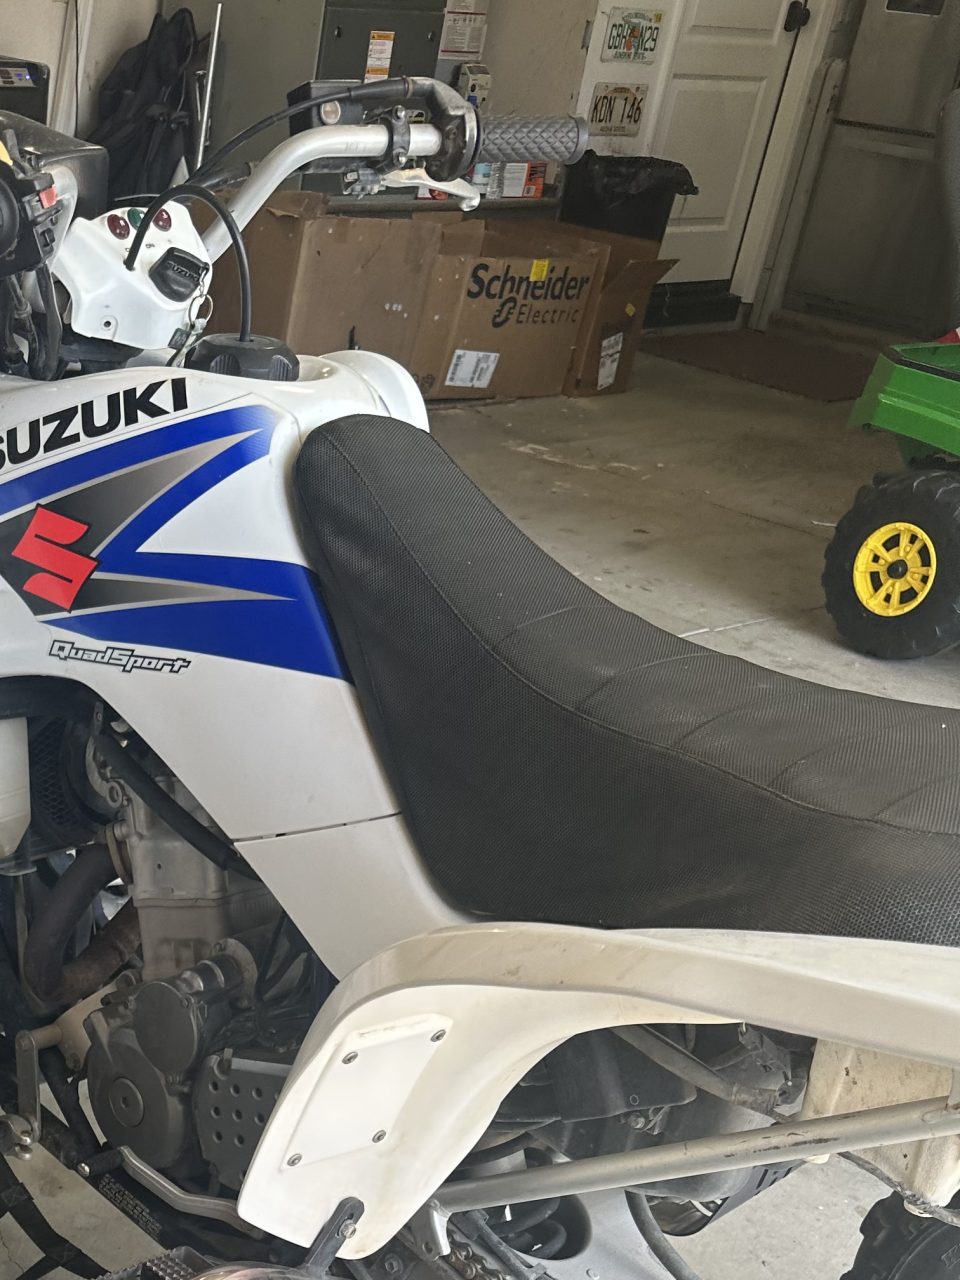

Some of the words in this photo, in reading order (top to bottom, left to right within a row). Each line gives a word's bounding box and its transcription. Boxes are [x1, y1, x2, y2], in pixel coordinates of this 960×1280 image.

[637, 25, 659, 52] N29
[591, 95, 616, 123] KDN
[620, 96, 644, 123] 146
[467, 263, 589, 300] Schneider
[516, 303, 579, 324] Electric
[48, 639, 191, 674] QuadSport
